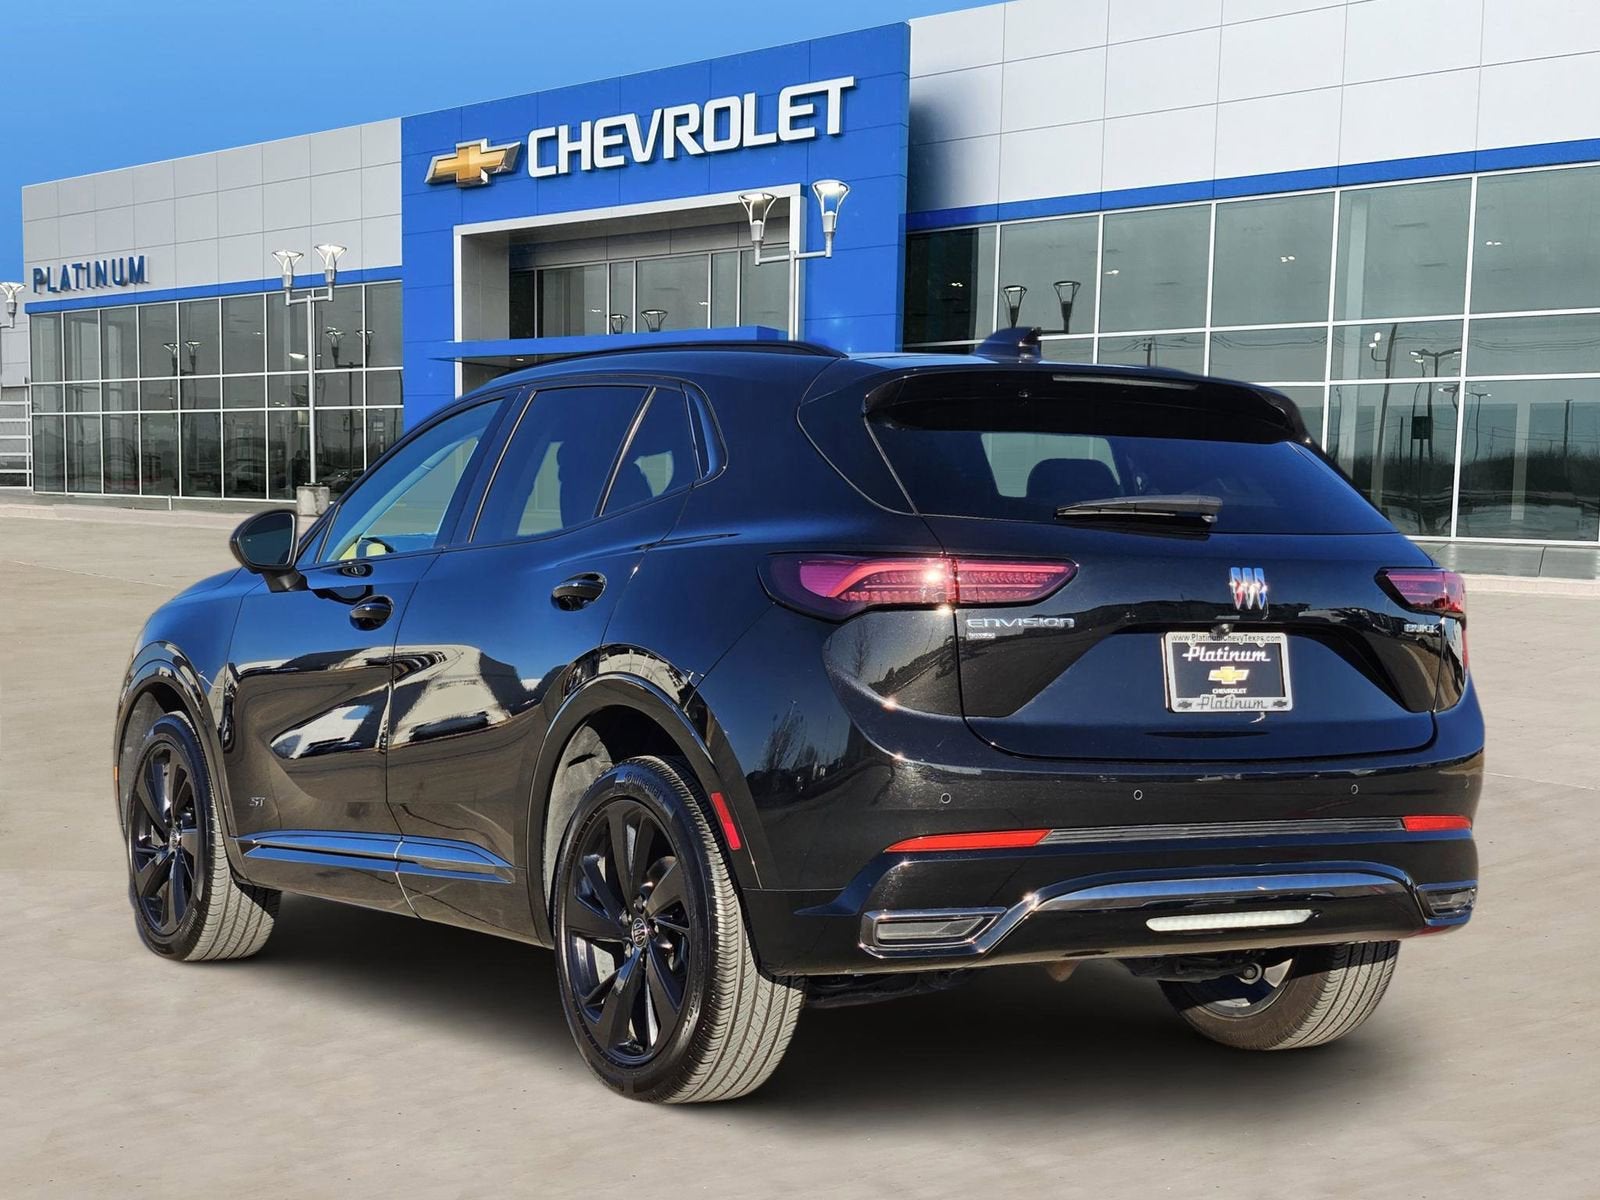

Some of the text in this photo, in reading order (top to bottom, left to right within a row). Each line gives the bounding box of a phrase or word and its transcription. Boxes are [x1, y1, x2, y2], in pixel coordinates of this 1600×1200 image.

[527, 75, 855, 178] CHEVROLET
[32, 255, 146, 294] PLATINUM
[1182, 645, 1271, 662] Platinum
[1211, 687, 1248, 695] CHEVROLET
[1196, 694, 1268, 710] Platinum
[248, 796, 266, 807] ST
